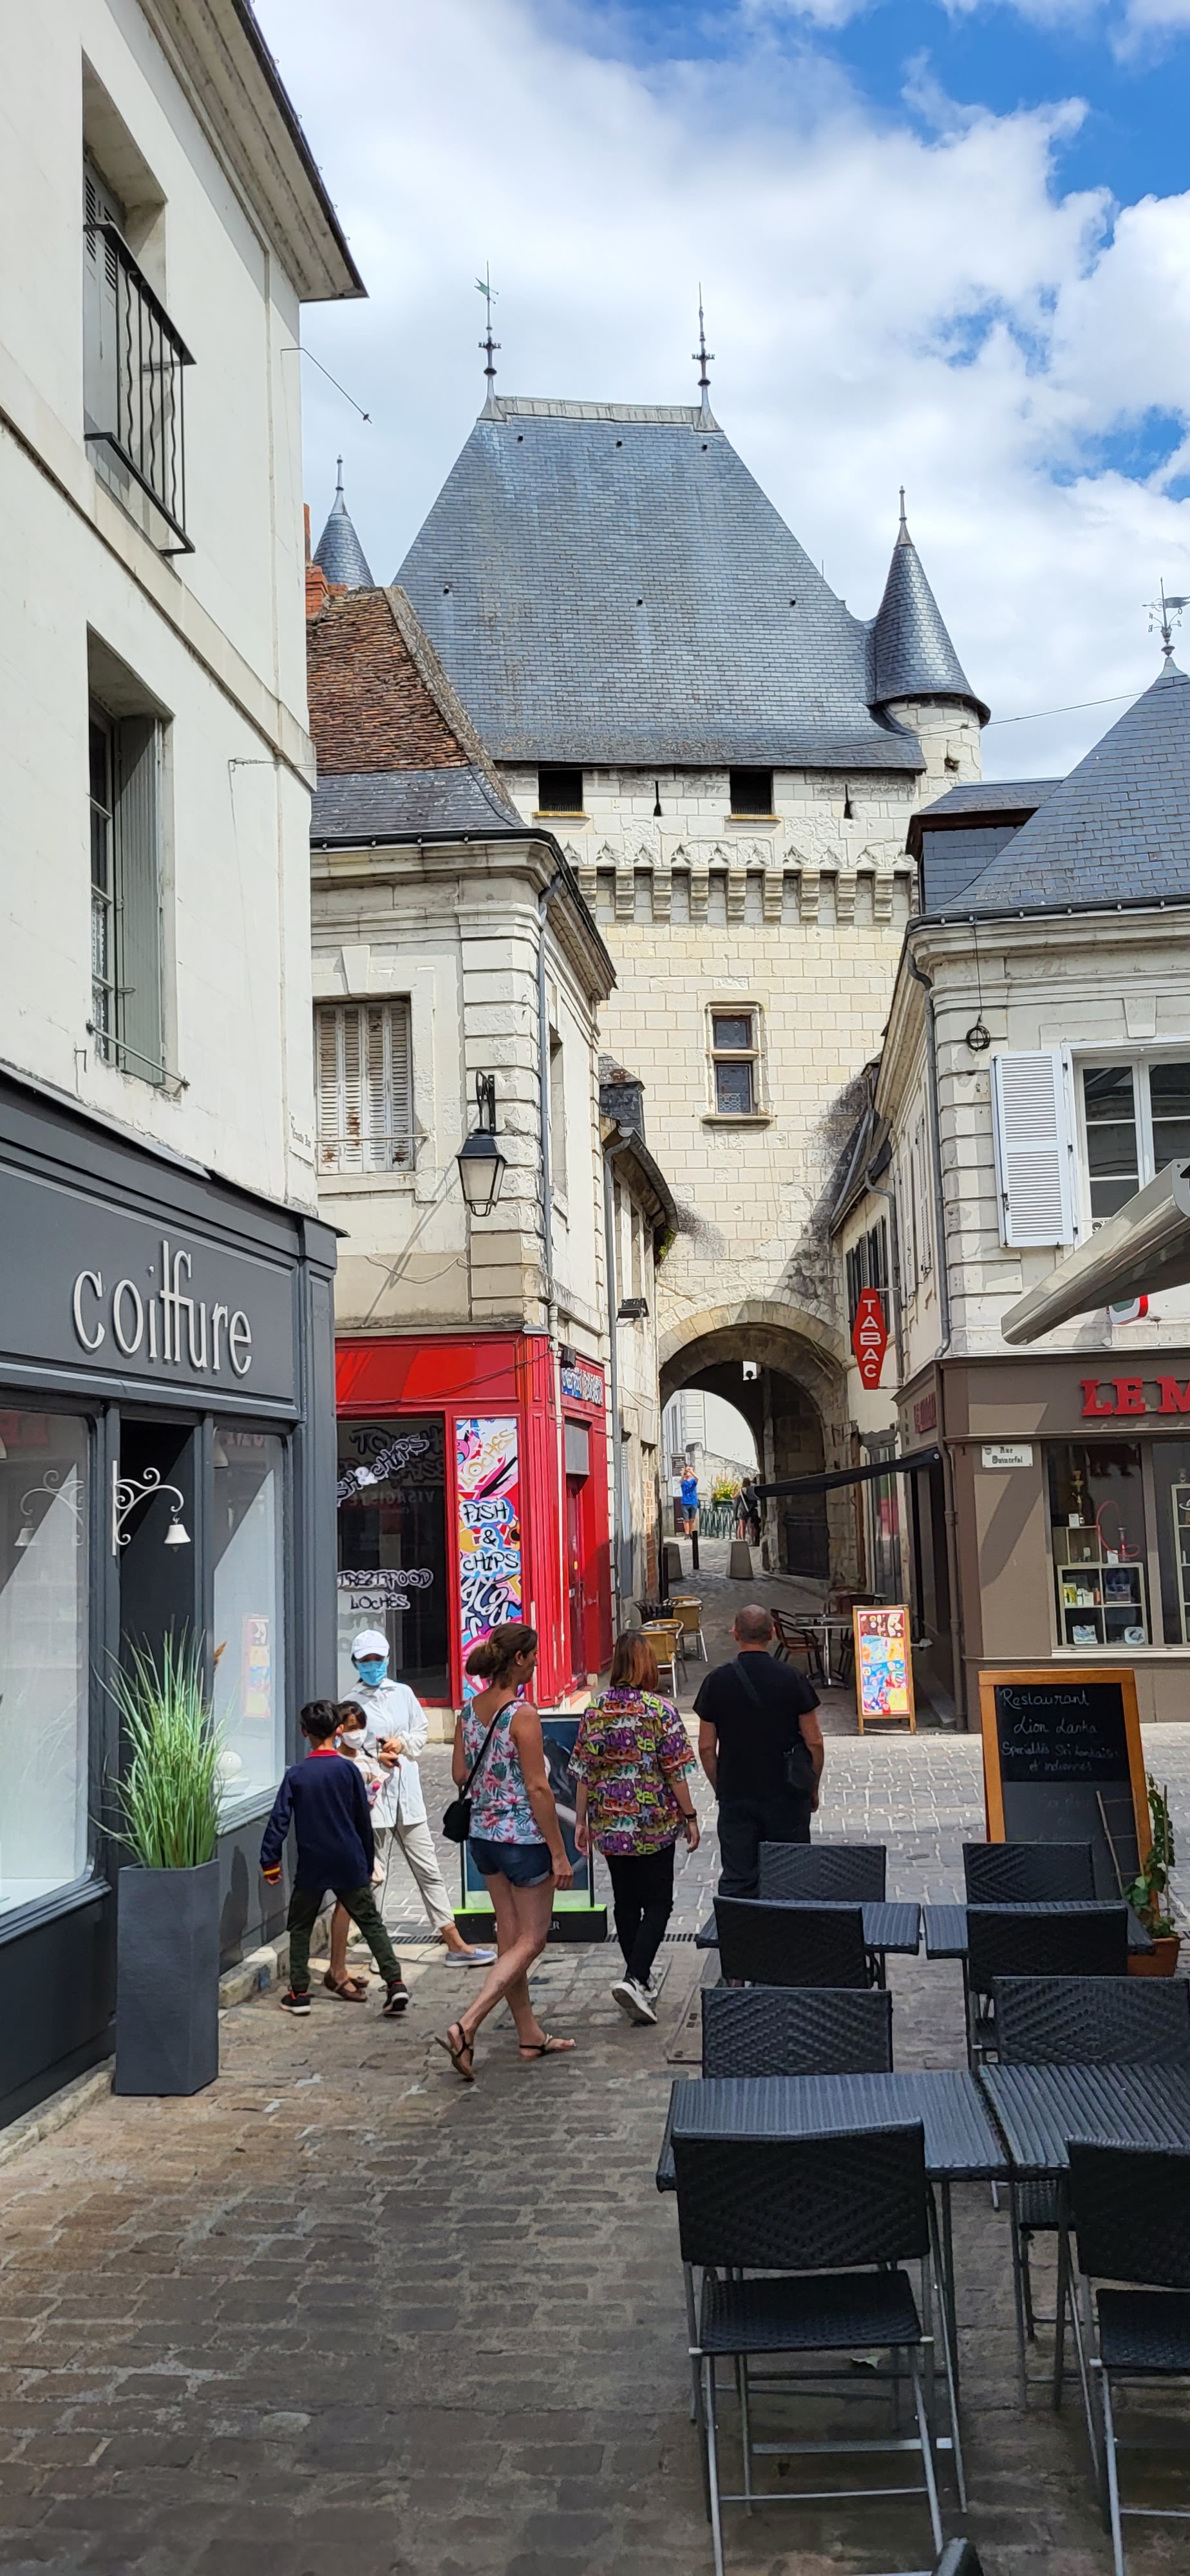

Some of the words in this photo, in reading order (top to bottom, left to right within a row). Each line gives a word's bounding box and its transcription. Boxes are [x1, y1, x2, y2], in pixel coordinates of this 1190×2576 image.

[73, 1240, 252, 1374] coiffure
[860, 1299, 882, 1378] TABAC
[1079, 1376, 1146, 1416] LE
[458, 1428, 516, 1489] LOCHES
[462, 1501, 508, 1524] FISH
[482, 1529, 497, 1546] &
[462, 1552, 519, 1572] CHIPS
[350, 1593, 411, 1610] LOCHES
[1000, 1688, 1090, 1709] Restaurant
[1014, 1716, 1050, 1735] Lion
[1055, 1718, 1098, 1734] Lanka
